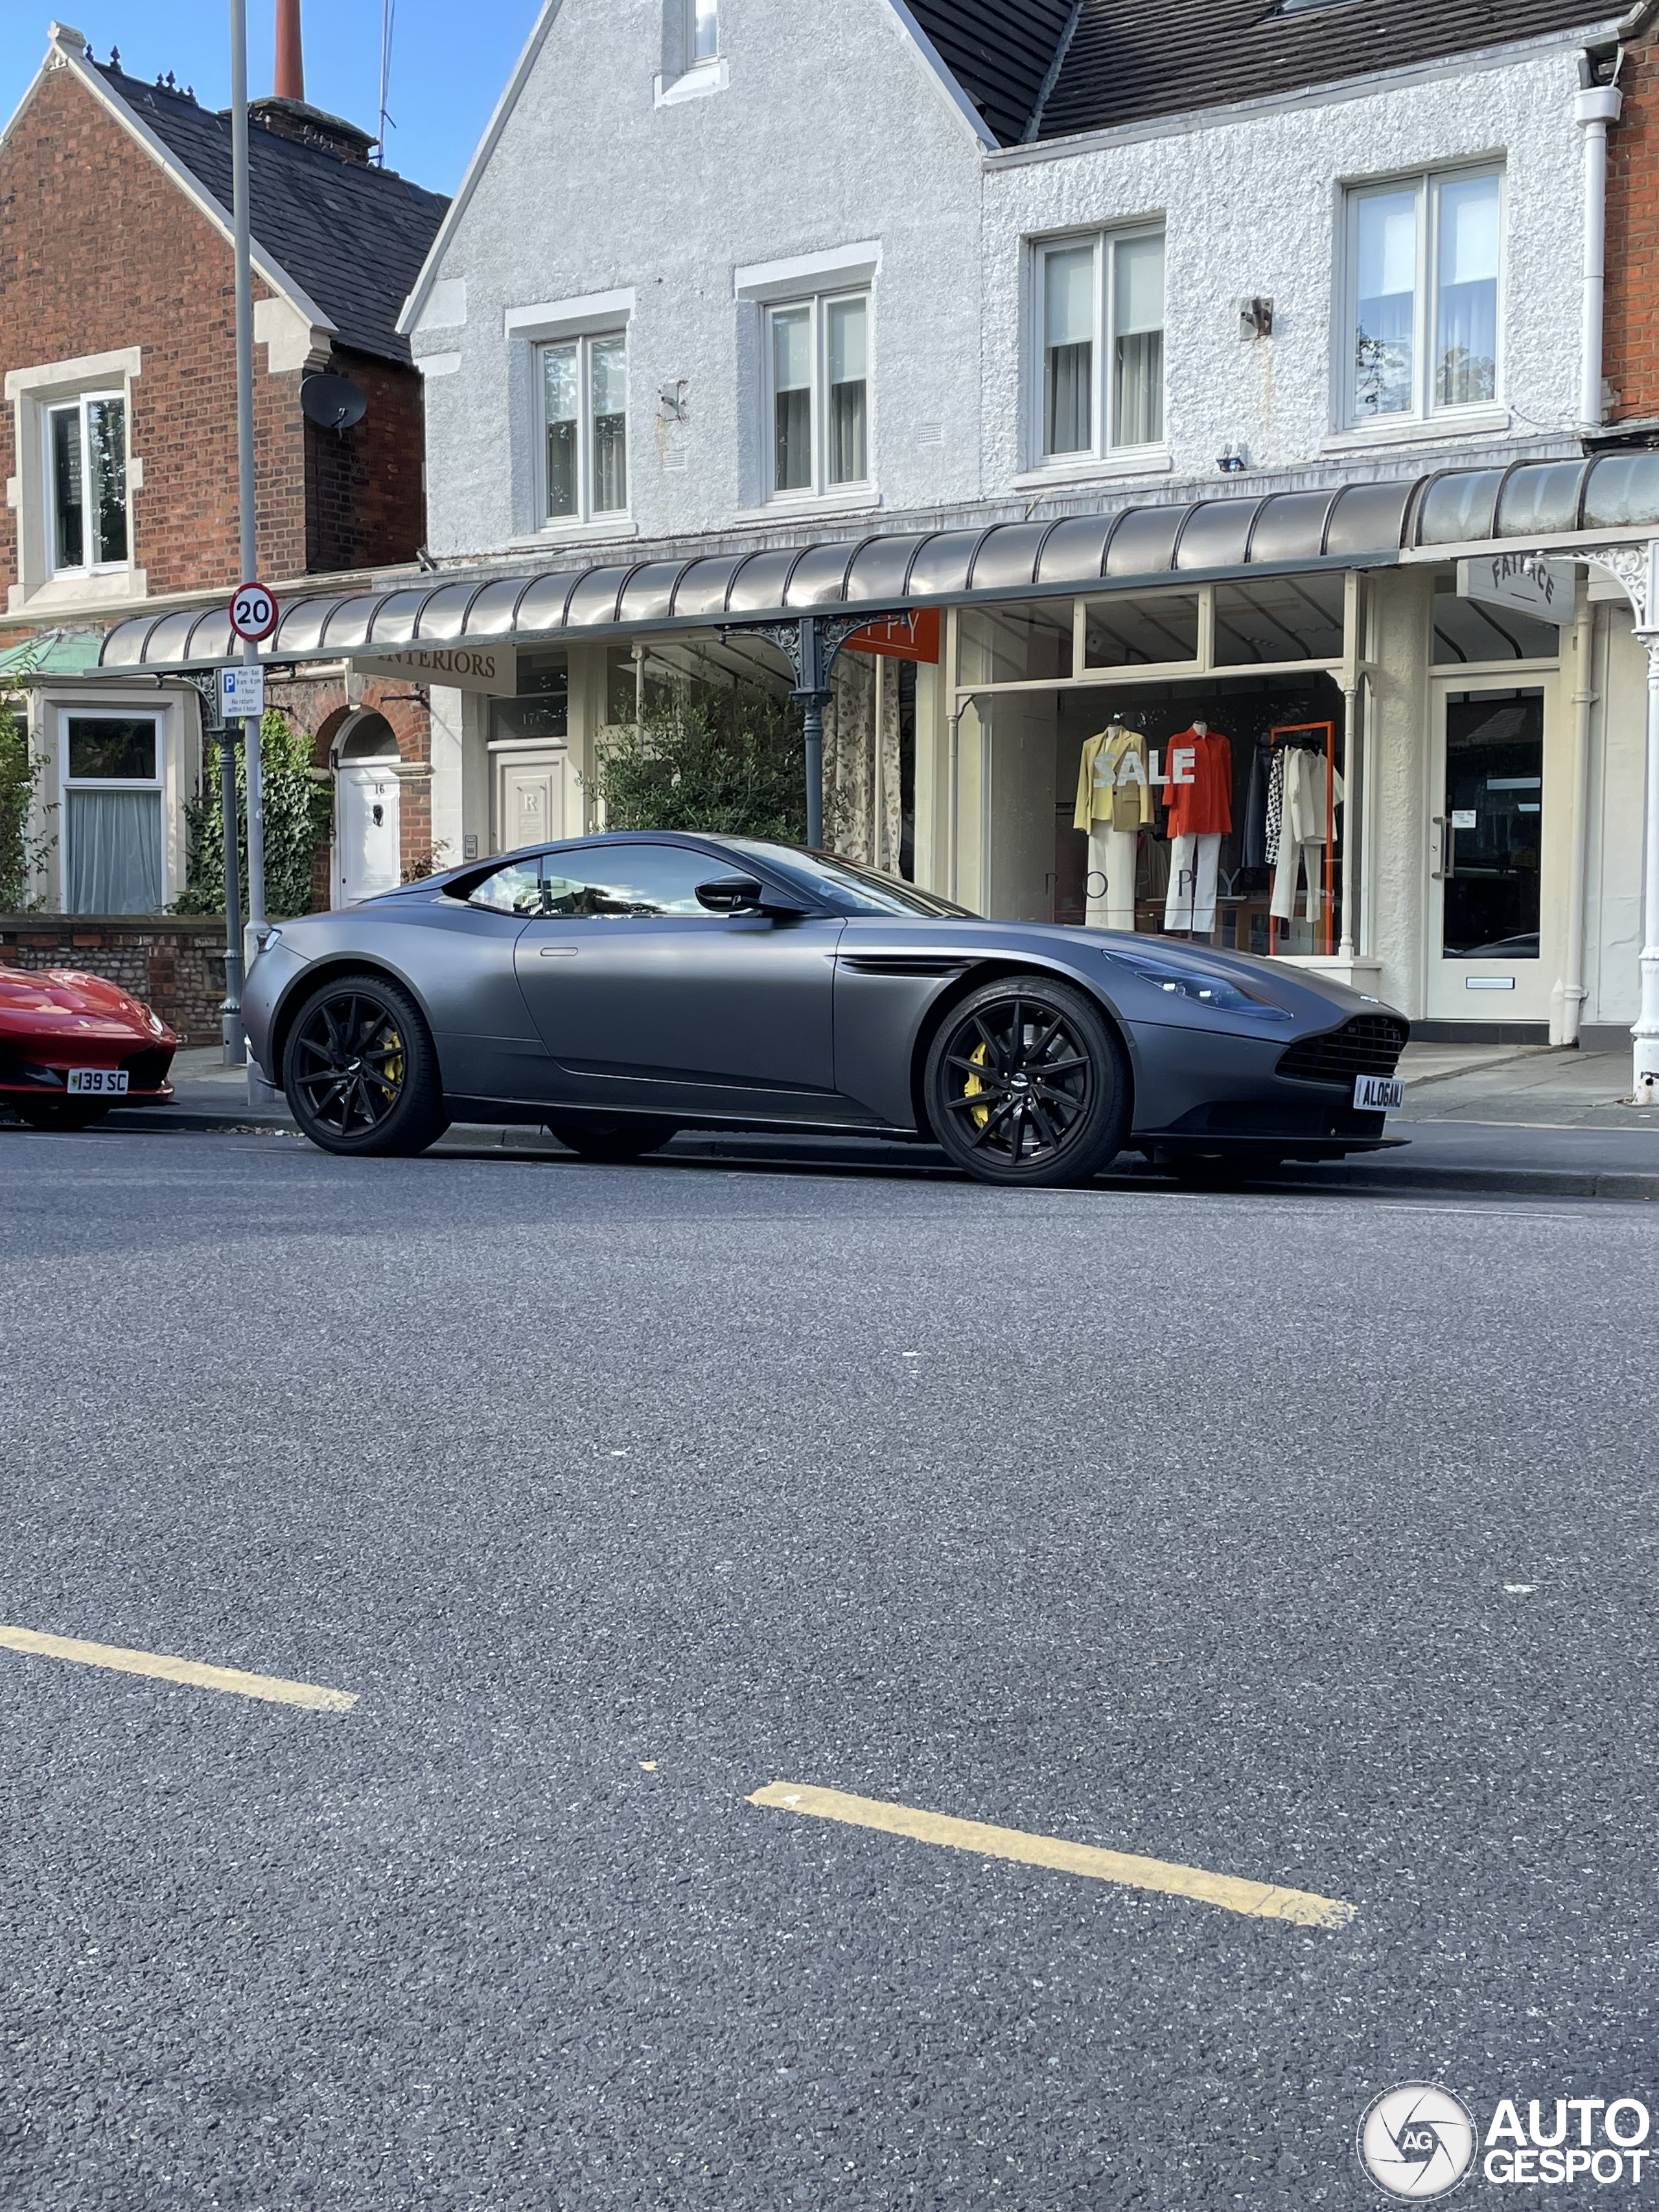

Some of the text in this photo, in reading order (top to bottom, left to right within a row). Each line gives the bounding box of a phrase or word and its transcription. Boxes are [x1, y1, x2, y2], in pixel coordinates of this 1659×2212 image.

[237, 600, 270, 624] 20
[226, 675, 234, 692] P
[1093, 748, 1195, 787] SALE
[375, 784, 385, 795] 16
[78, 1072, 126, 1091] 139 SC
